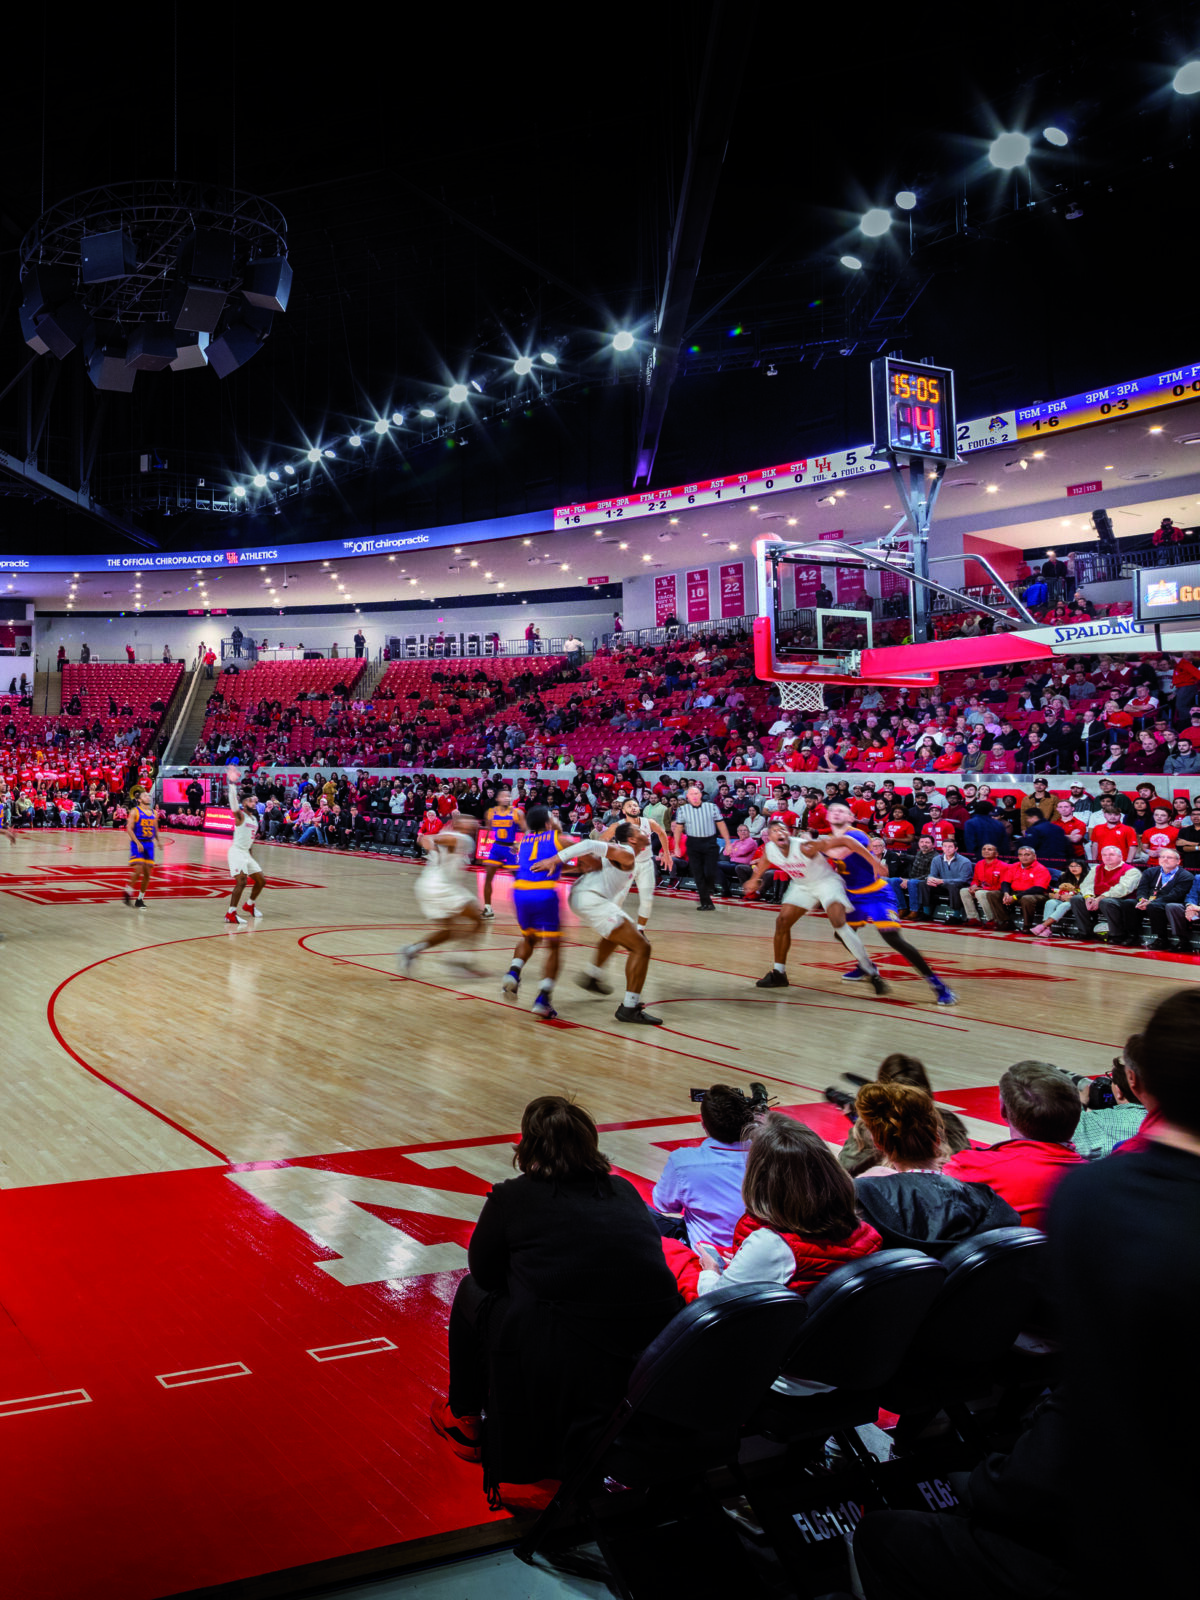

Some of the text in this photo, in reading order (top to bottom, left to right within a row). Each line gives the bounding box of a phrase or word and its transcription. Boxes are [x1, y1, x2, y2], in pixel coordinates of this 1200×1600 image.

[1158, 370, 1182, 386] FTM
[895, 373, 939, 403] 15:05
[1085, 382, 1139, 404] 3PM 3PA
[1019, 400, 1067, 420] FGM FGA
[957, 425, 970, 440] 2
[846, 451, 857, 466] 5
[790, 462, 805, 473] STL
[738, 475, 748, 483] TO
[762, 468, 777, 479] BLK
[794, 474, 803, 483] 0
[684, 485, 698, 494] REB
[710, 480, 725, 489] AST
[740, 485, 746, 494] 1
[766, 480, 774, 489] 0
[1072, 484, 1096, 495] 112 113
[640, 490, 672, 502] FTM FTA
[687, 495, 695, 504] 6
[715, 490, 721, 499] 1
[597, 498, 629, 510] 3PM 3PA
[375, 534, 429, 548] chiropractic
[122, 557, 154, 566] OFFICIAL
[155, 555, 212, 565] CHIROPRACTOR
[213, 554, 224, 562] OF
[240, 550, 277, 560] ATHLETICS
[799, 570, 817, 581] 42
[691, 588, 704, 598] 10
[725, 582, 739, 593] 22
